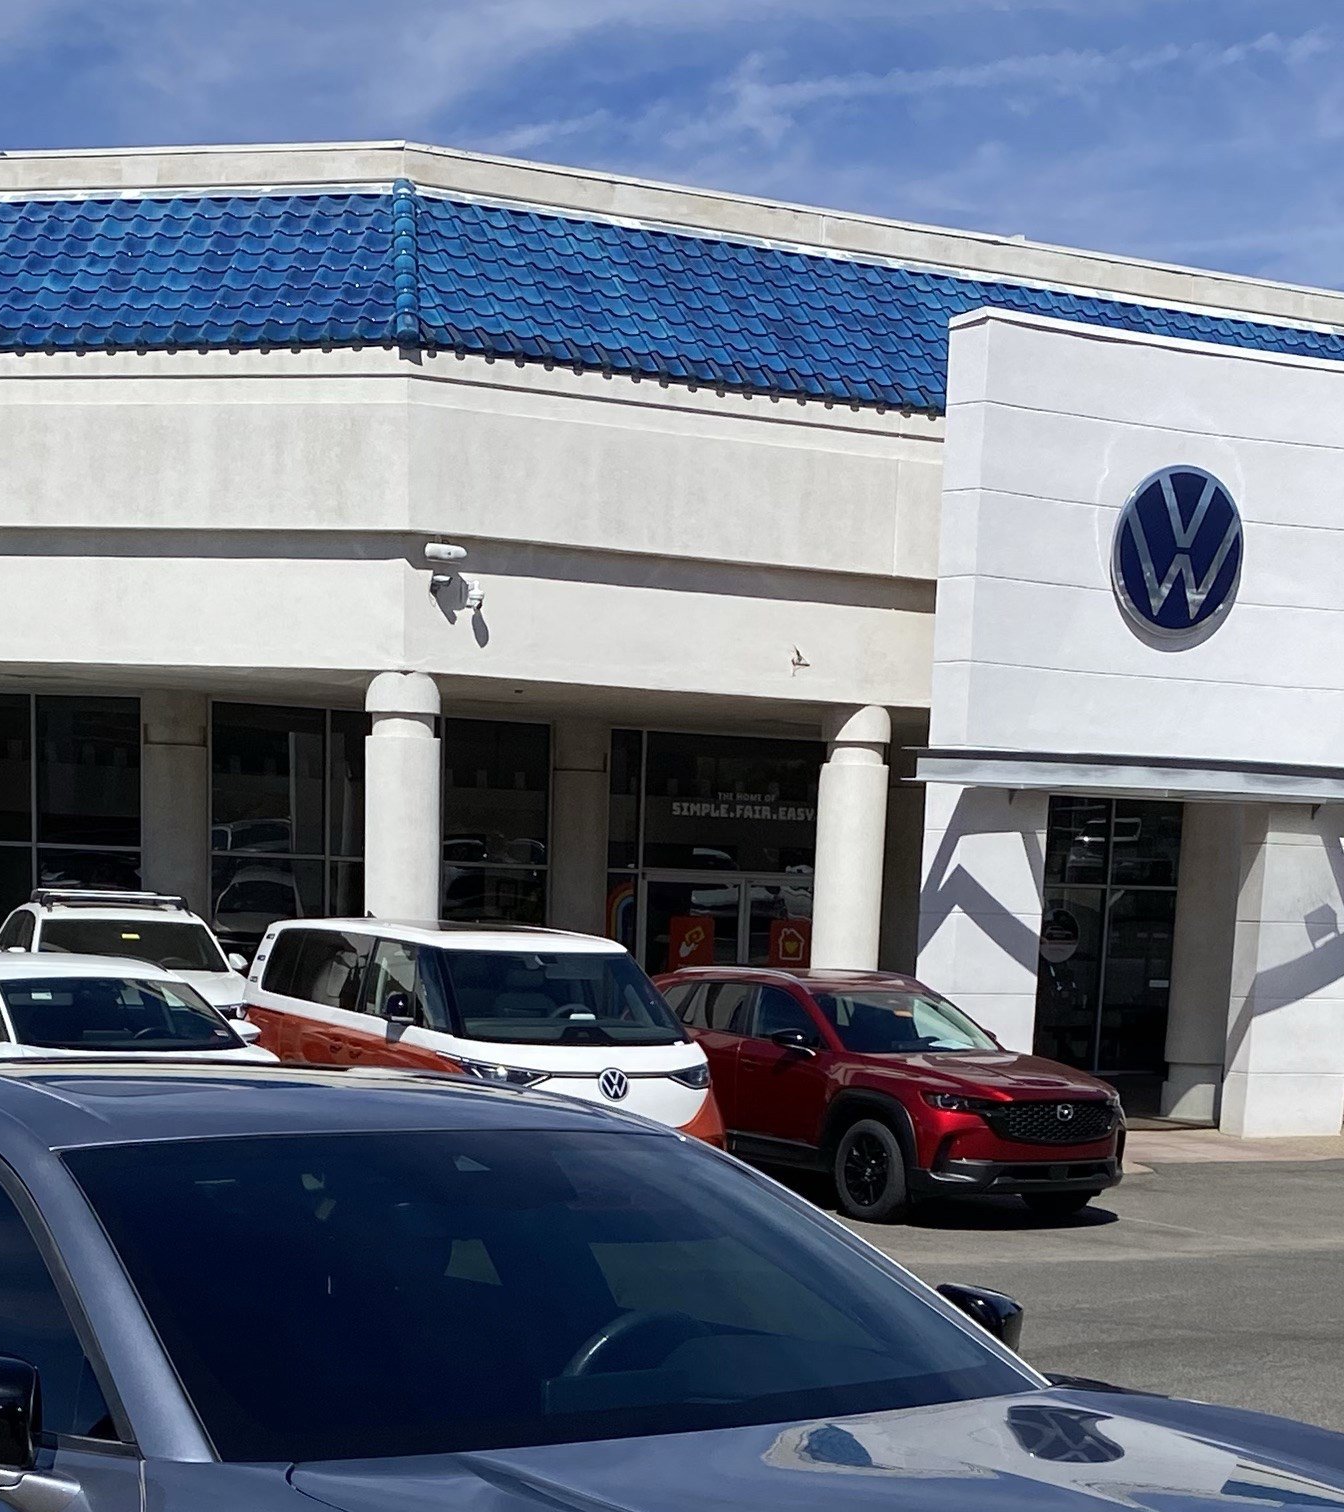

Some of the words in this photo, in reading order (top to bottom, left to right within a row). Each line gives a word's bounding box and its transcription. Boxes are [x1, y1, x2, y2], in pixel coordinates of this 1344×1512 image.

[1115, 467, 1242, 626] VW
[717, 791, 734, 801] THE
[736, 792, 762, 802] HOME
[764, 793, 776, 803] OF
[600, 1069, 627, 1100] VW
